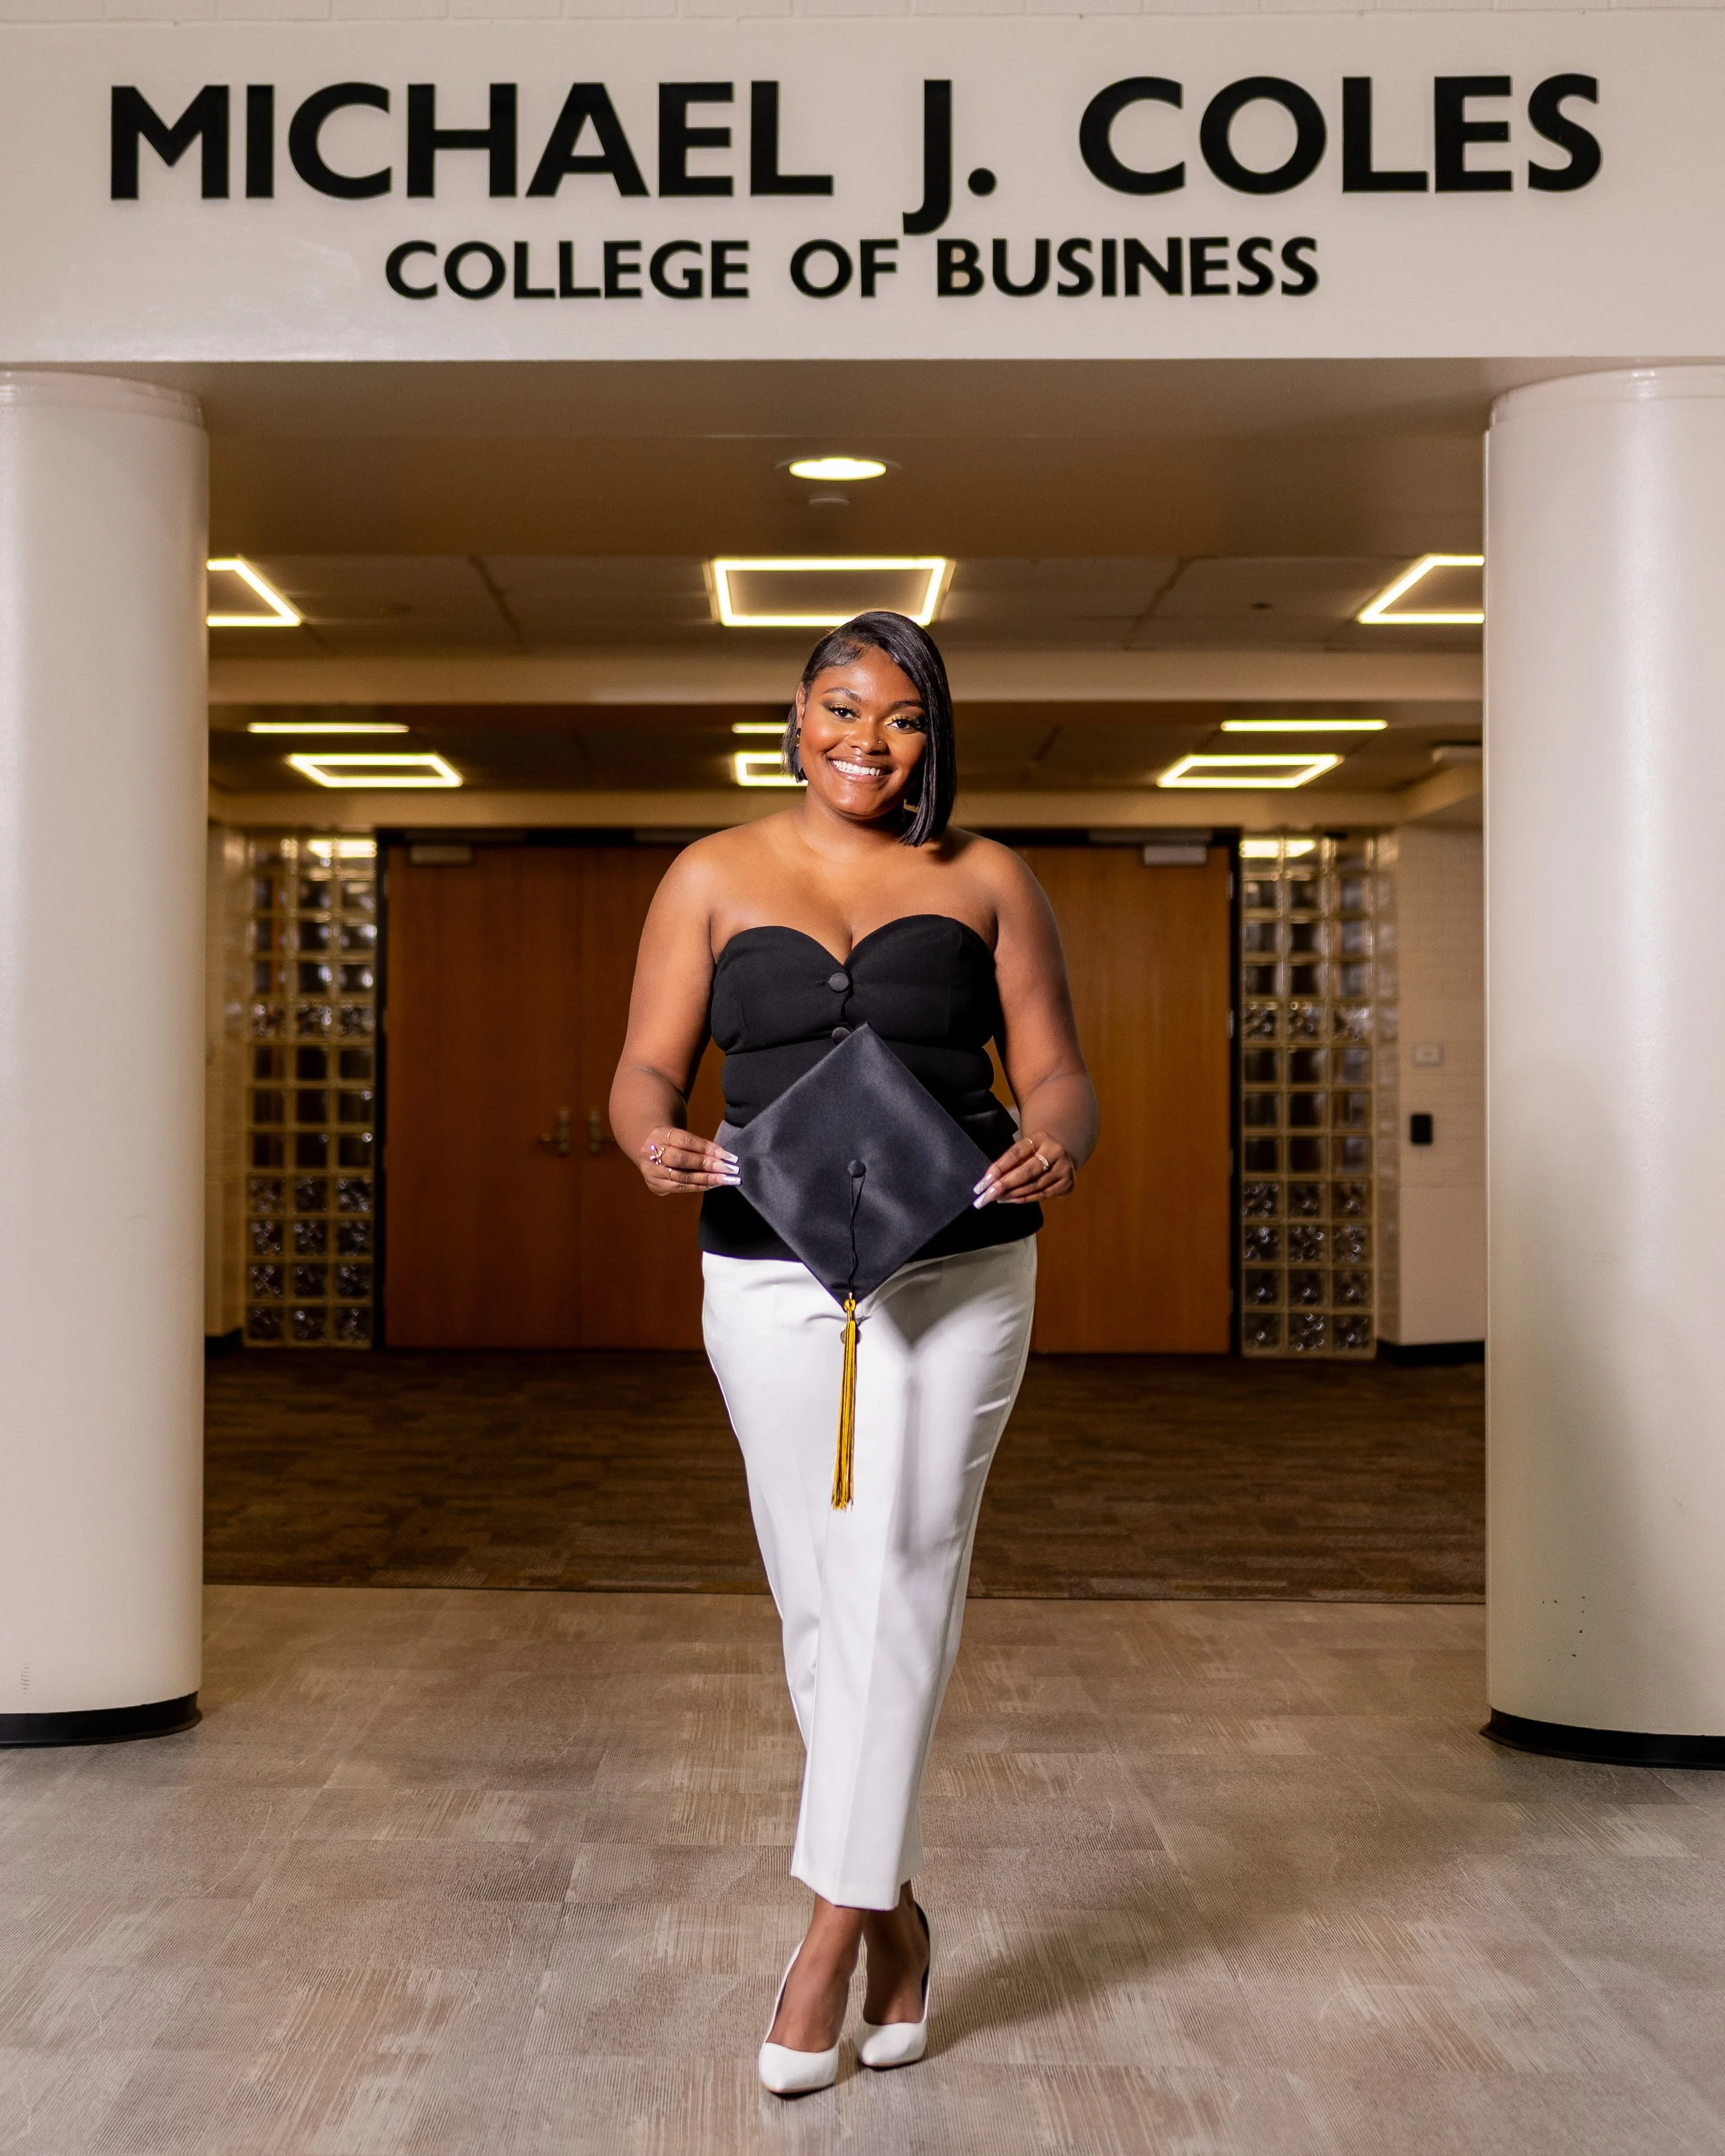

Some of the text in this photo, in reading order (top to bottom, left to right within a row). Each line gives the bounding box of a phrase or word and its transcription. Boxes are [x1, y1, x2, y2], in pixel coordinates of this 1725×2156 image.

[110, 73, 1602, 236] MICHAEL J. COLES
[384, 236, 1319, 300] COLLEGE OF BUSINESS
